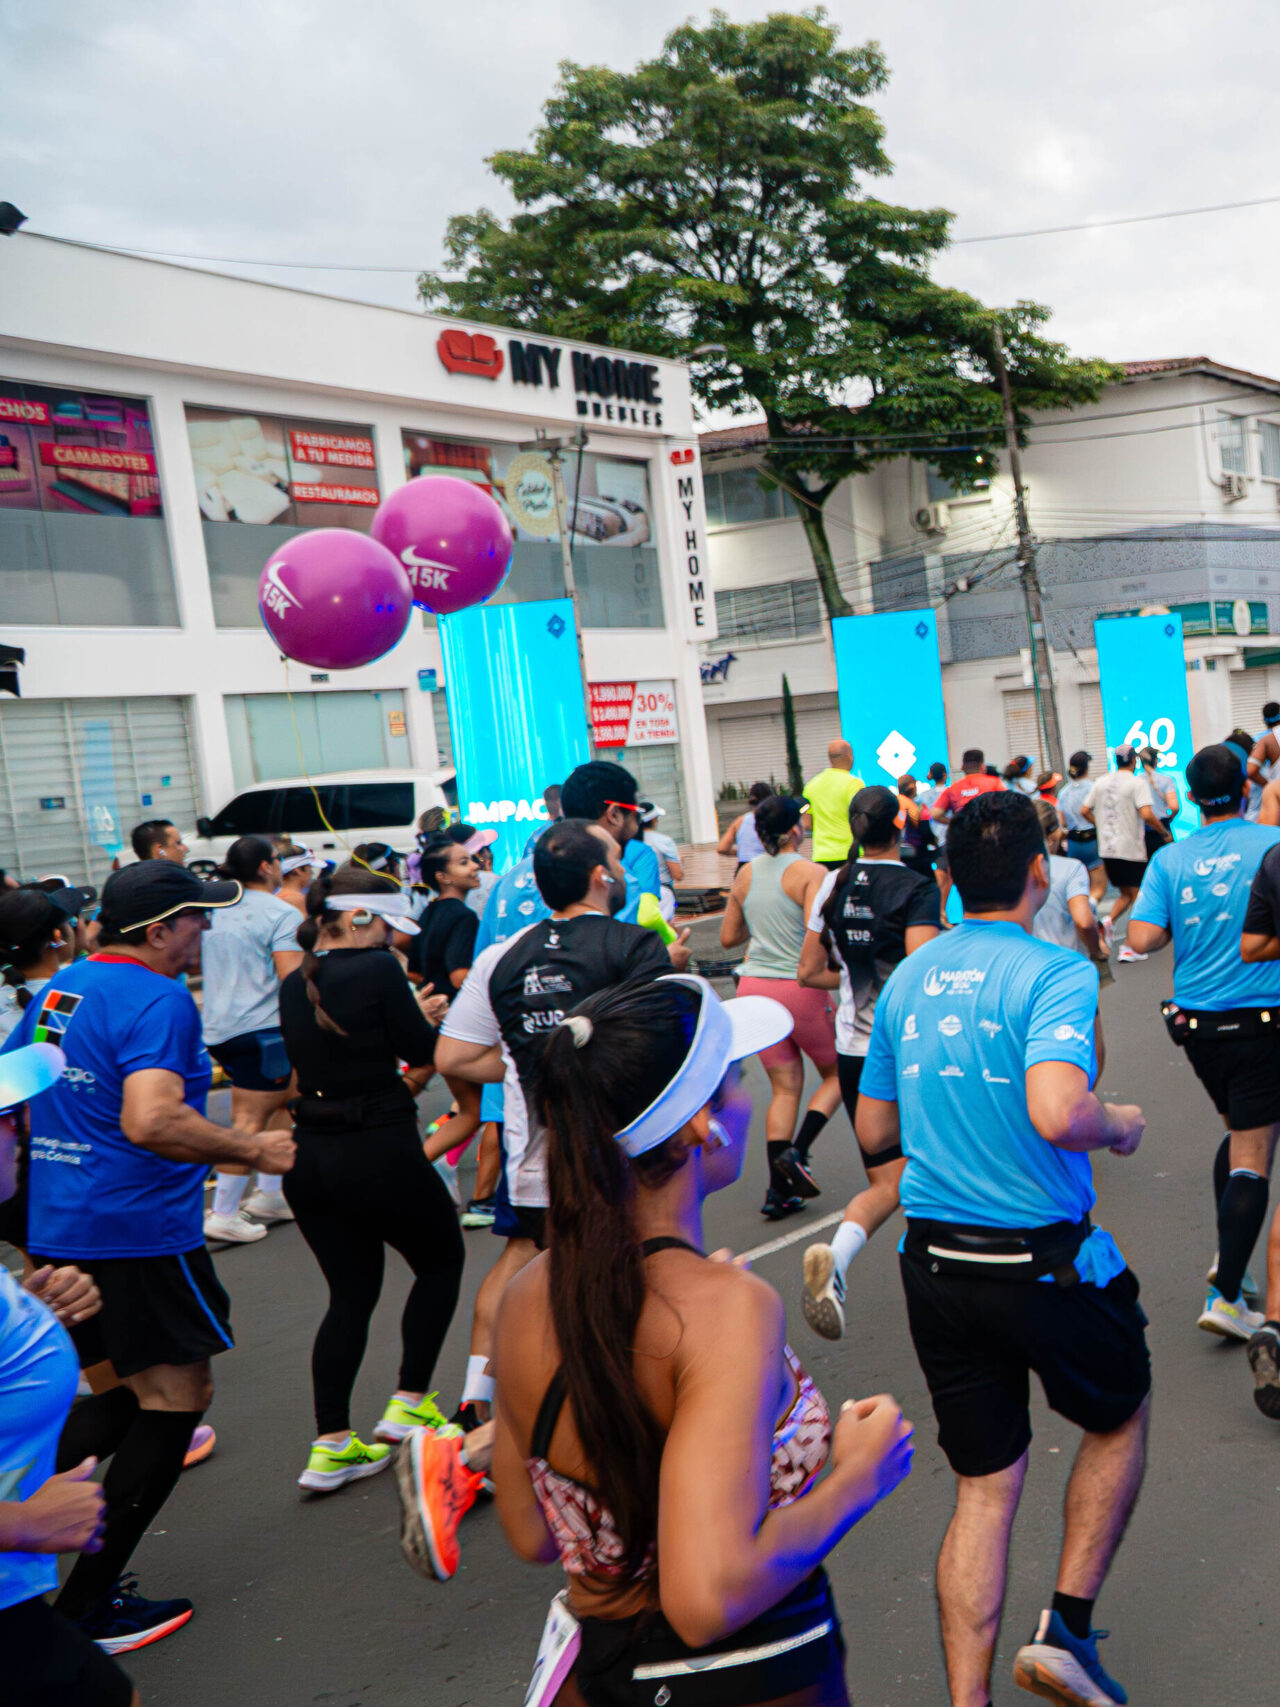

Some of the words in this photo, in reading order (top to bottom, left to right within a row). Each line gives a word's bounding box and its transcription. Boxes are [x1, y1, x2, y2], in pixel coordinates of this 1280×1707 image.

[508, 340, 562, 389] MY
[571, 351, 662, 405] HOME
[576, 400, 663, 427] MUEBLES
[295, 434, 372, 452] FABRICAMOS
[53, 447, 149, 470] CAMAROTES
[297, 447, 306, 460] A
[308, 448, 324, 461] TU
[327, 451, 375, 466] MEDIDA
[294, 486, 378, 503] RESTAURAMOS
[408, 566, 450, 591] 15K
[685, 530, 704, 626] HOME
[262, 583, 291, 619] 15K
[637, 693, 674, 712] 30%
[647, 730, 675, 739] TIENDA
[1124, 717, 1175, 753] 60
